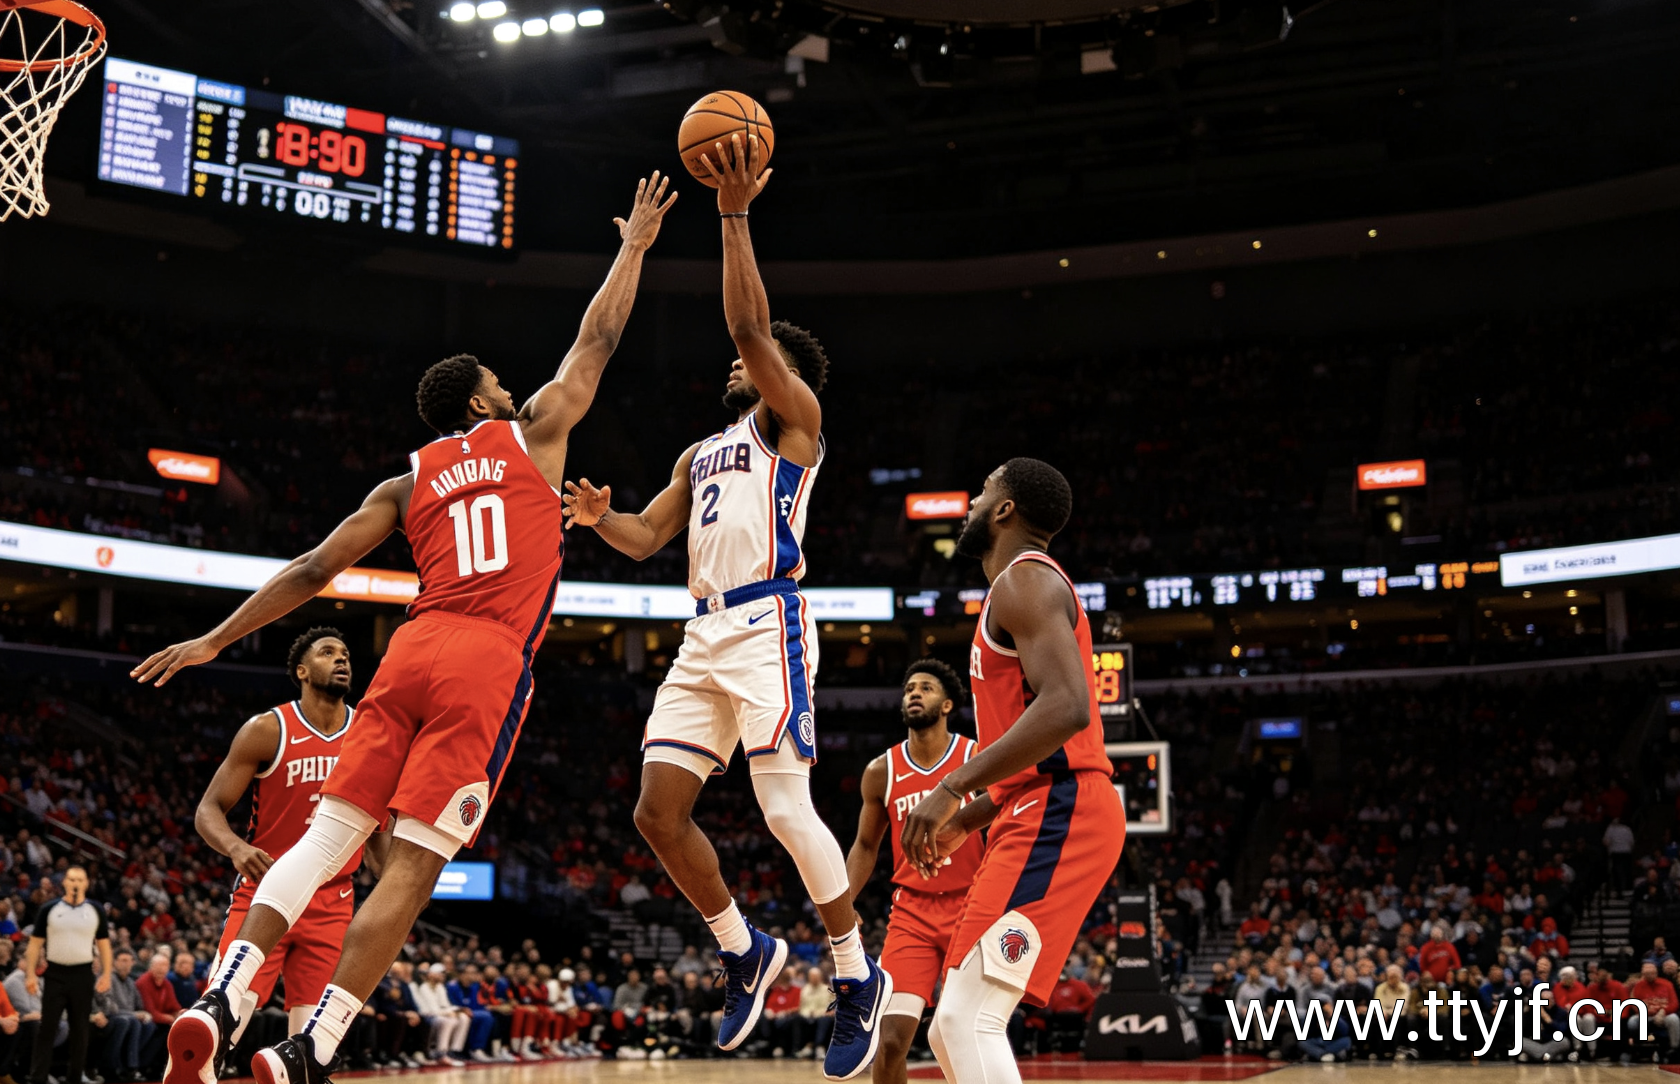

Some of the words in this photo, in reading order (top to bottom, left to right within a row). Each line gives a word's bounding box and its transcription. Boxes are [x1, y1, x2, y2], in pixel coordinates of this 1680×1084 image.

[701, 483, 720, 528] 2
[449, 494, 508, 577] 10
[1098, 1014, 1168, 1034] KIA
